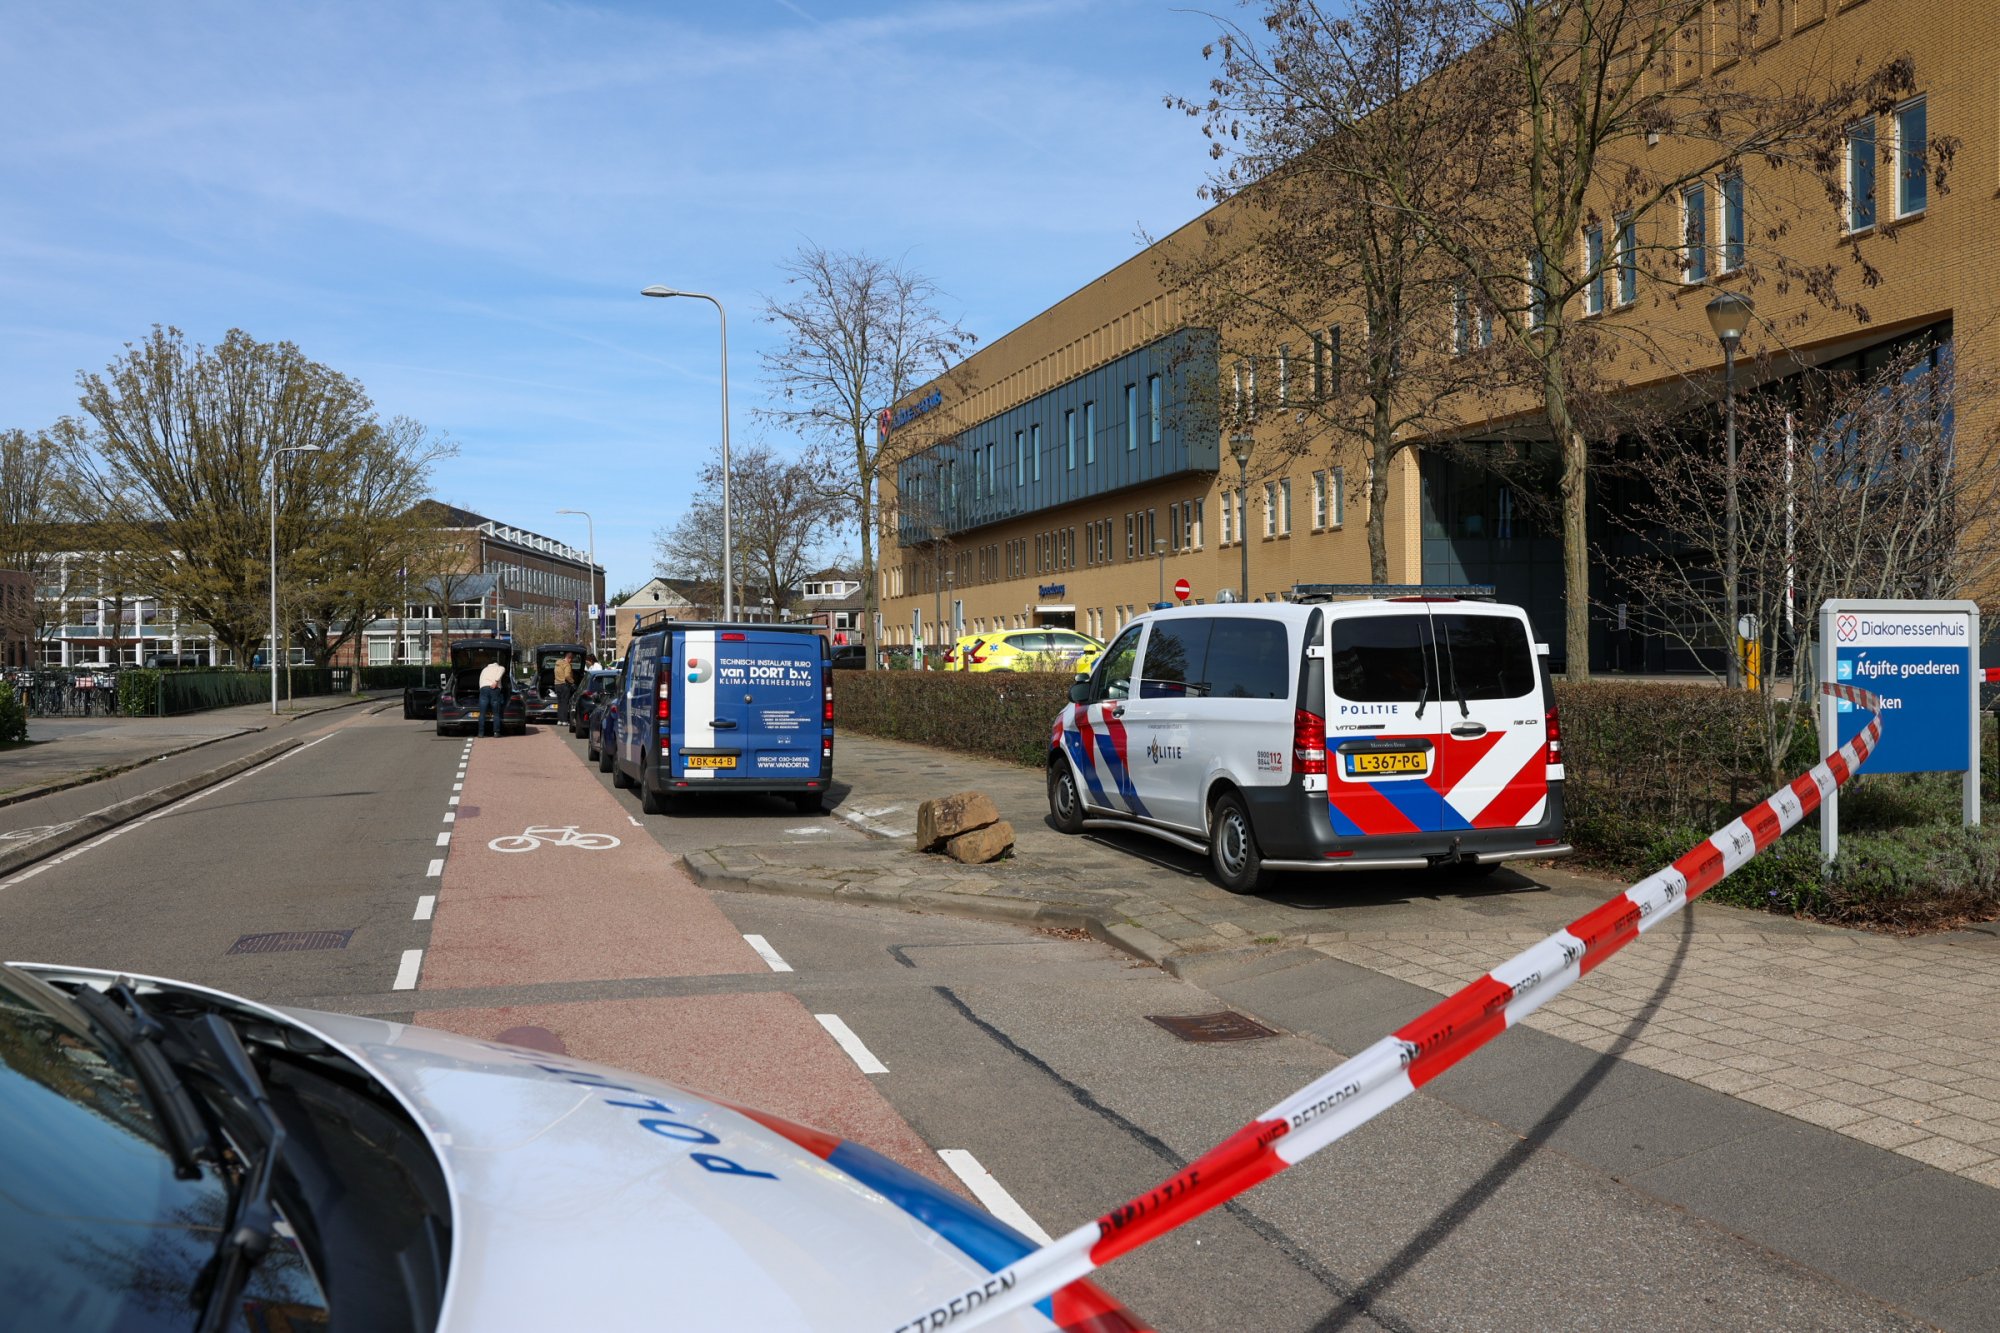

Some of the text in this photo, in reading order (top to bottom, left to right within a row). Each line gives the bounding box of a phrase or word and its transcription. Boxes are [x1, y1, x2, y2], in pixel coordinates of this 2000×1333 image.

[1861, 621, 1964, 636] Diakonessenhuis
[720, 667, 811, 680] van DORT b.v.
[1856, 660, 1960, 679] Afgifte goederen
[720, 678, 811, 686] KLIMAATBEHEERSING
[1341, 705, 1398, 715] POLITIE
[1270, 752, 1282, 764] 112
[1360, 755, 1420, 770] L-367-PG
